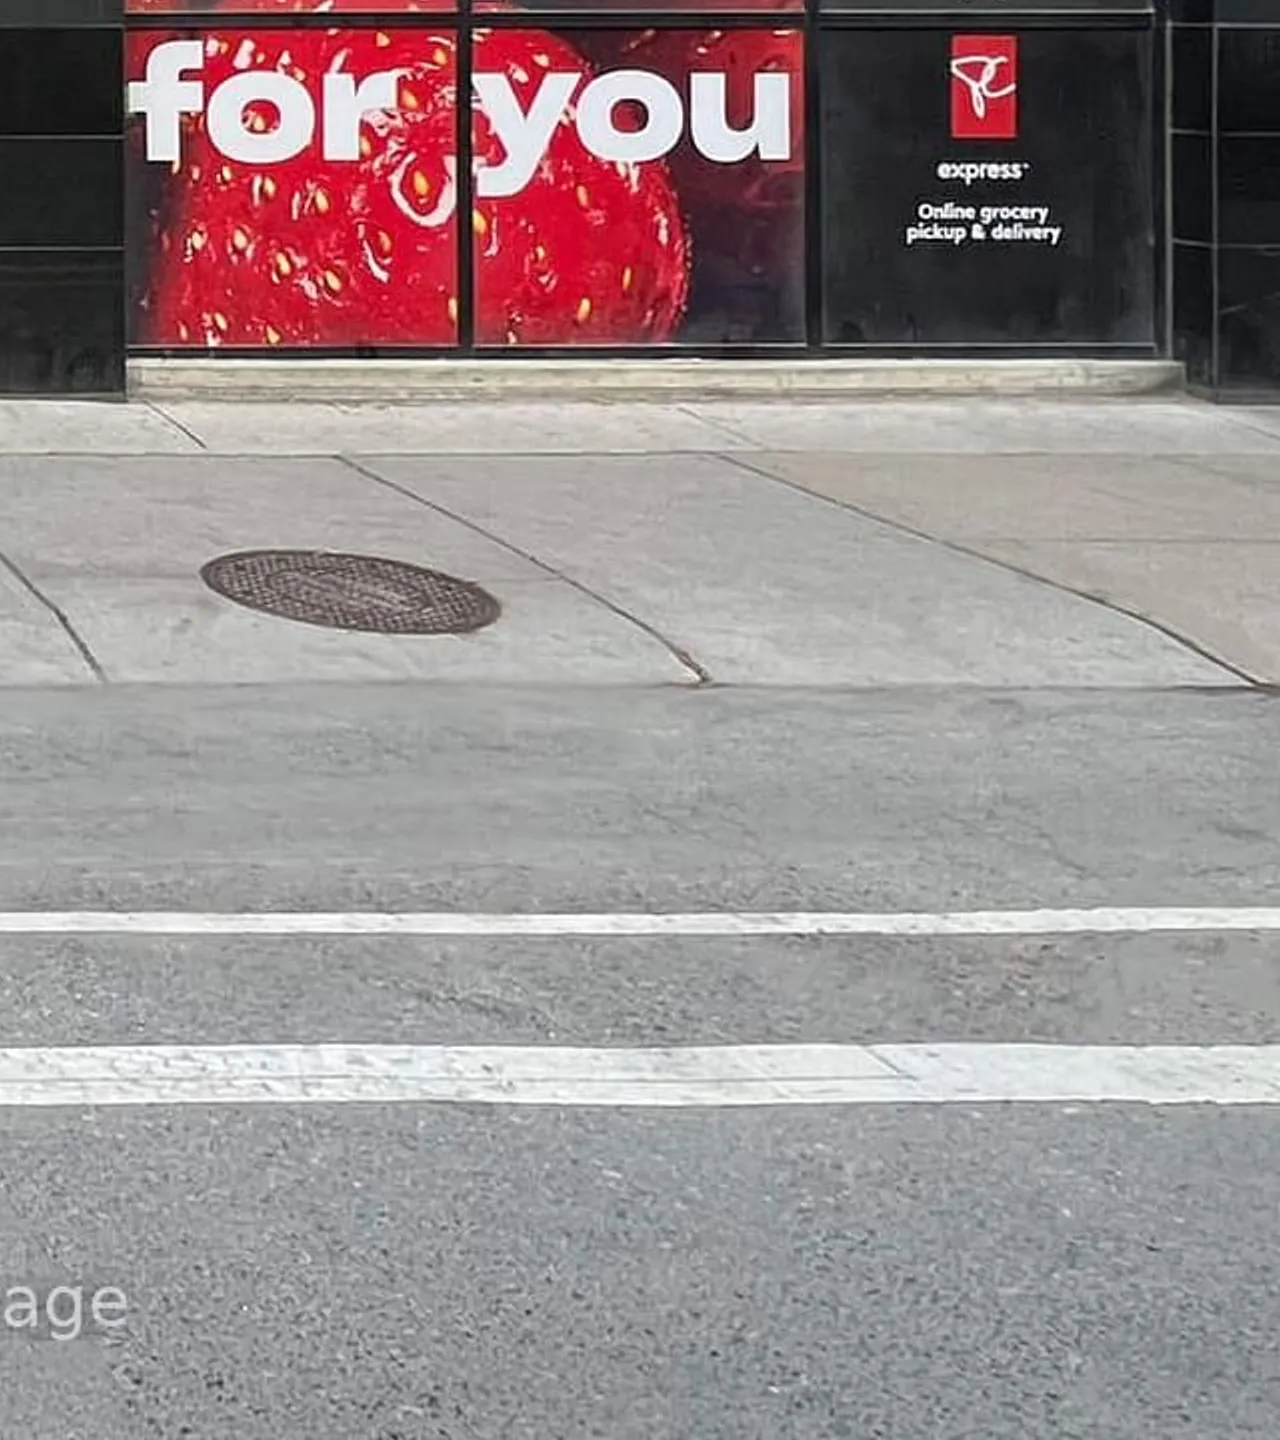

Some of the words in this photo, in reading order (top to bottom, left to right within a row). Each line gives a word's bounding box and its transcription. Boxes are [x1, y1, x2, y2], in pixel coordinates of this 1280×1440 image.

[128, 41, 400, 163] for
[472, 69, 791, 197] you
[918, 203, 976, 220] Online
[980, 206, 1049, 224] grocery
[906, 223, 967, 245] pickup
[971, 224, 986, 240] &
[991, 222, 1062, 245] delivery
